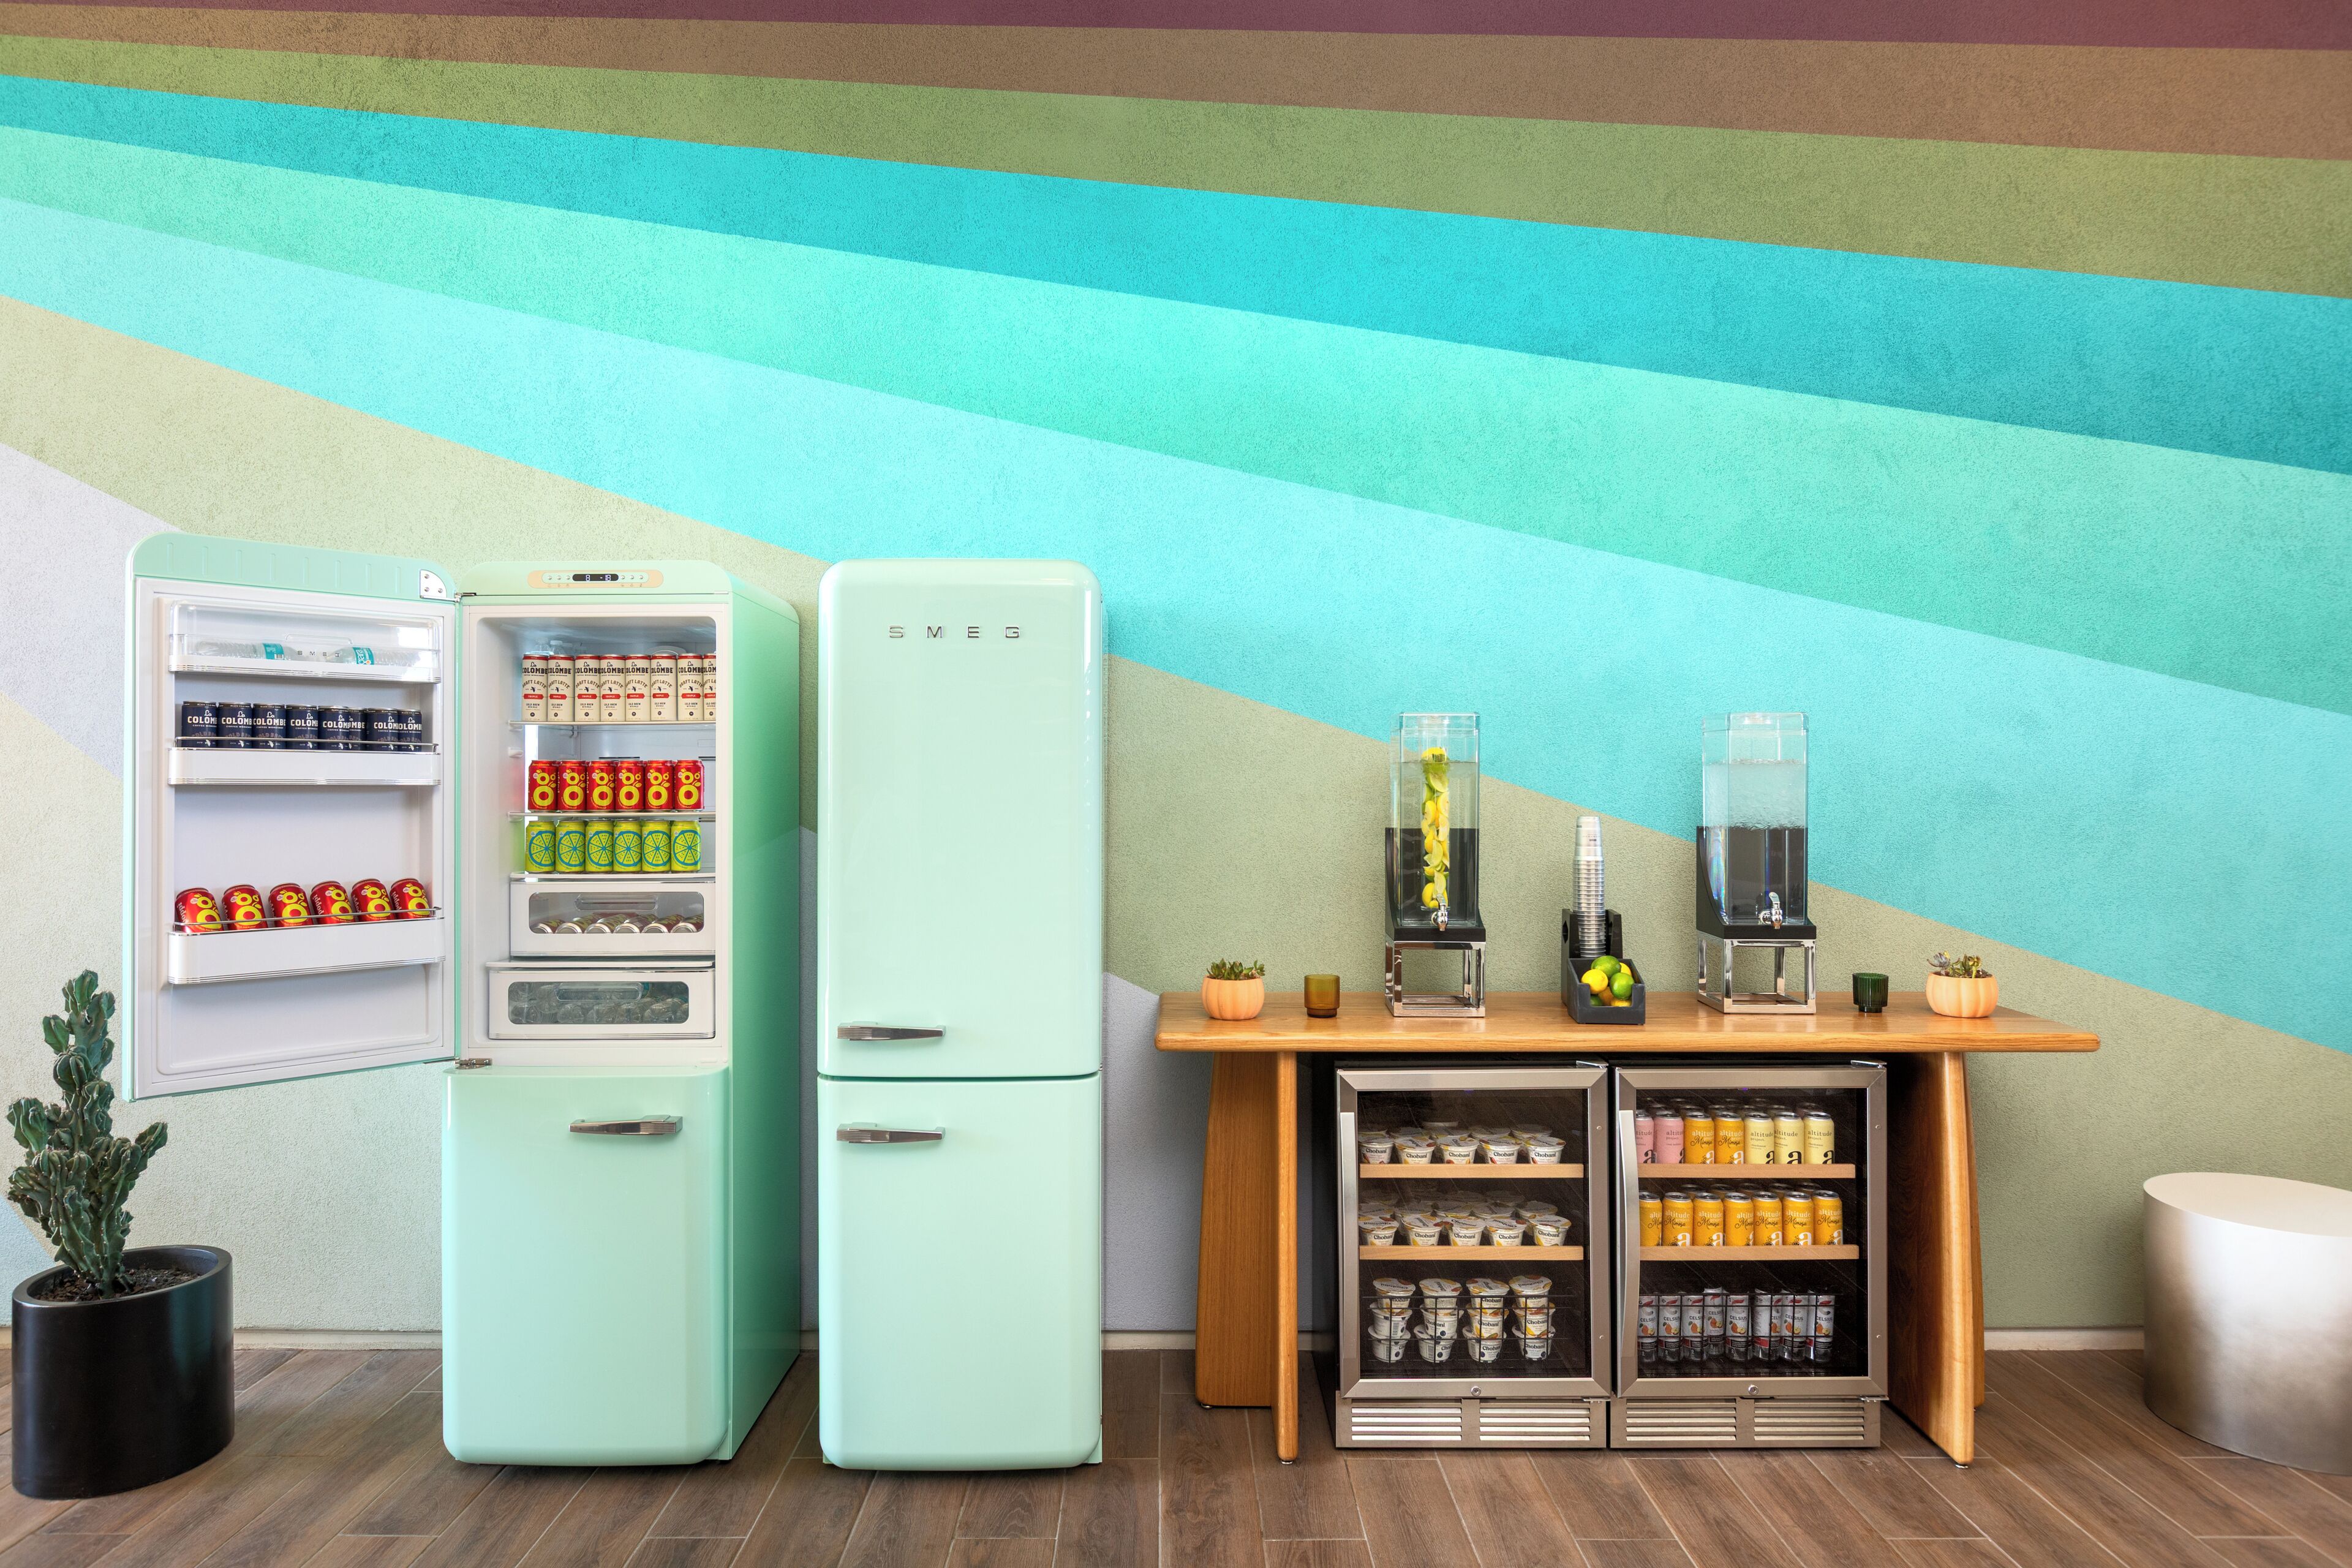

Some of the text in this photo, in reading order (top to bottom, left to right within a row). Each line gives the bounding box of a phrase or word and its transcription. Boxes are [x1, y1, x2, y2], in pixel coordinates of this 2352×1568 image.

[889, 625, 1019, 638] SMEG
[1664, 1215, 1686, 1229] Mimosa
[1697, 1216, 1719, 1230] Mimosa
[1755, 1215, 1778, 1229] Mimosa
[1784, 1215, 1807, 1229] Mimosa
[1425, 1319, 1446, 1327] Choani
